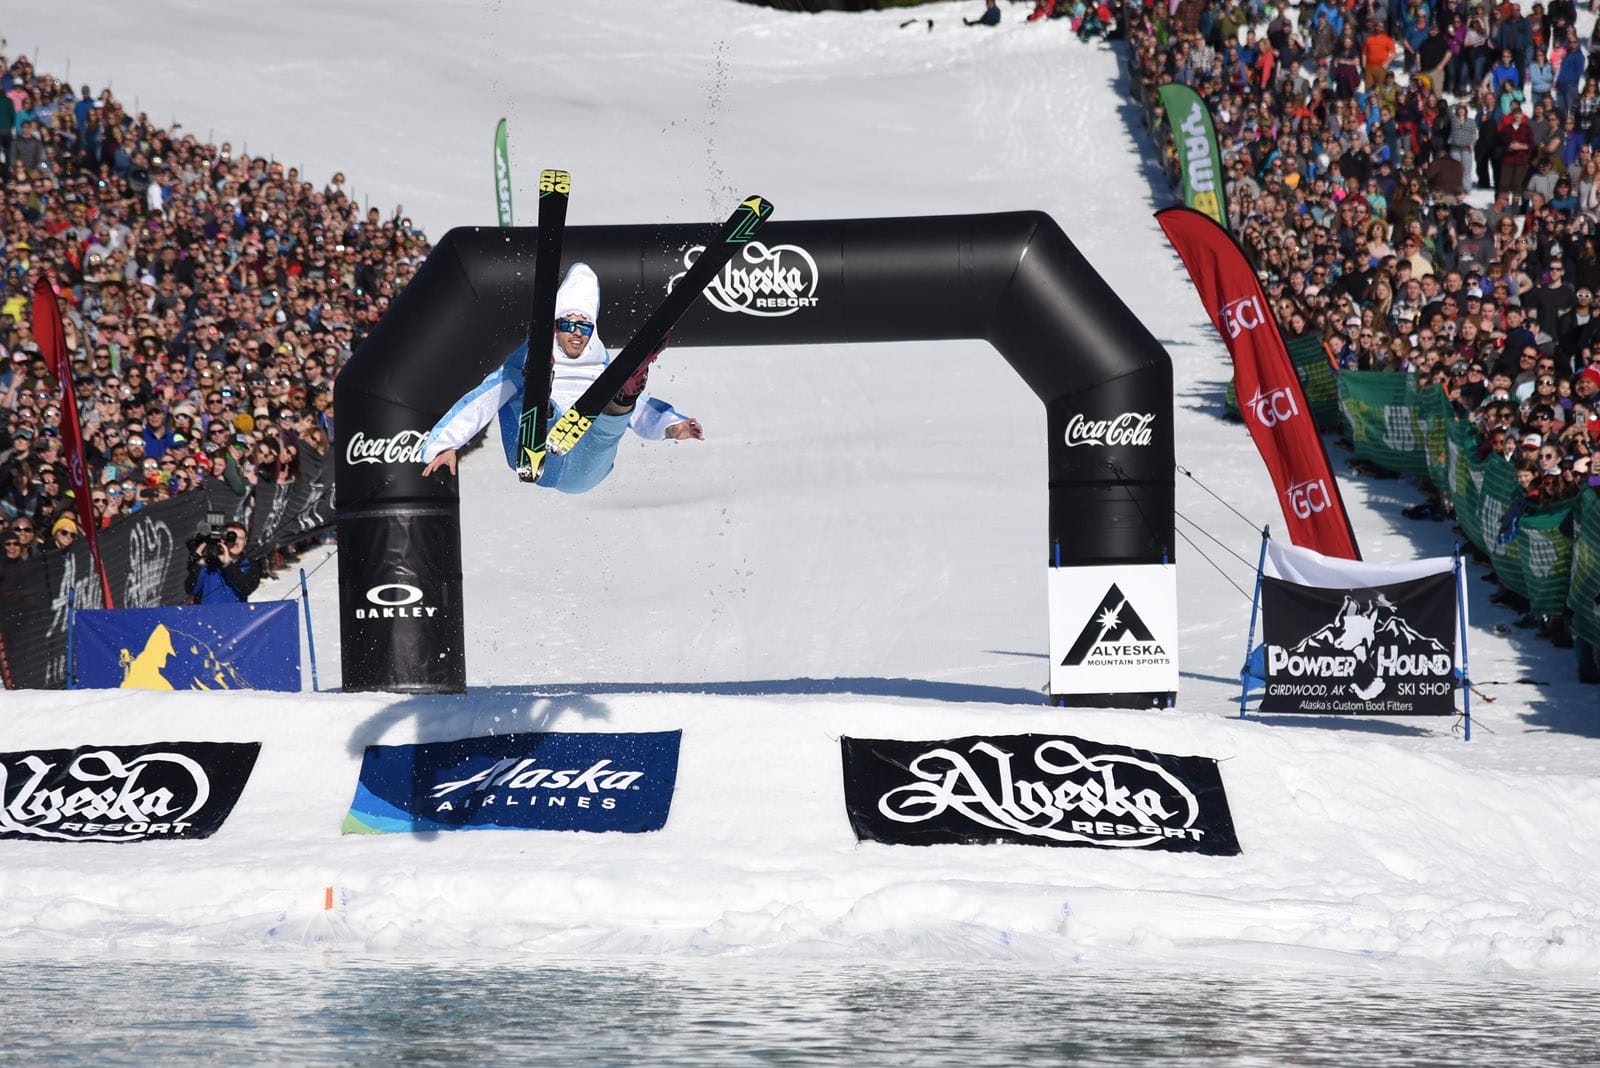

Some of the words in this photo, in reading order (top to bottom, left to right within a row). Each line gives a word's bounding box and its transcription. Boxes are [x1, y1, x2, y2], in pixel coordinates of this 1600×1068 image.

[755, 297, 819, 308] RESORT
[1223, 295, 1265, 339] GCI
[1256, 386, 1299, 428] GCI
[1064, 412, 1156, 447] Coca-Cola
[1291, 479, 1332, 519] GCI
[355, 606, 438, 619] OAKLEY
[1091, 645, 1166, 656] ALYESKA
[1269, 684, 1328, 697] GIRDWOOD,
[1331, 684, 1345, 696] AK
[1398, 683, 1416, 696] SKI
[1419, 683, 1450, 696] SHOP
[1300, 700, 1332, 710] Alaska's
[1332, 701, 1365, 711] Custom
[1366, 701, 1387, 711] Boot
[1387, 701, 1413, 711] Fitters
[430, 758, 645, 798] Alaska
[878, 740, 1199, 846] Alyeska
[436, 795, 616, 812] AIRLINES
[59, 821, 192, 834] RESORT
[1072, 820, 1205, 842] RESORT
